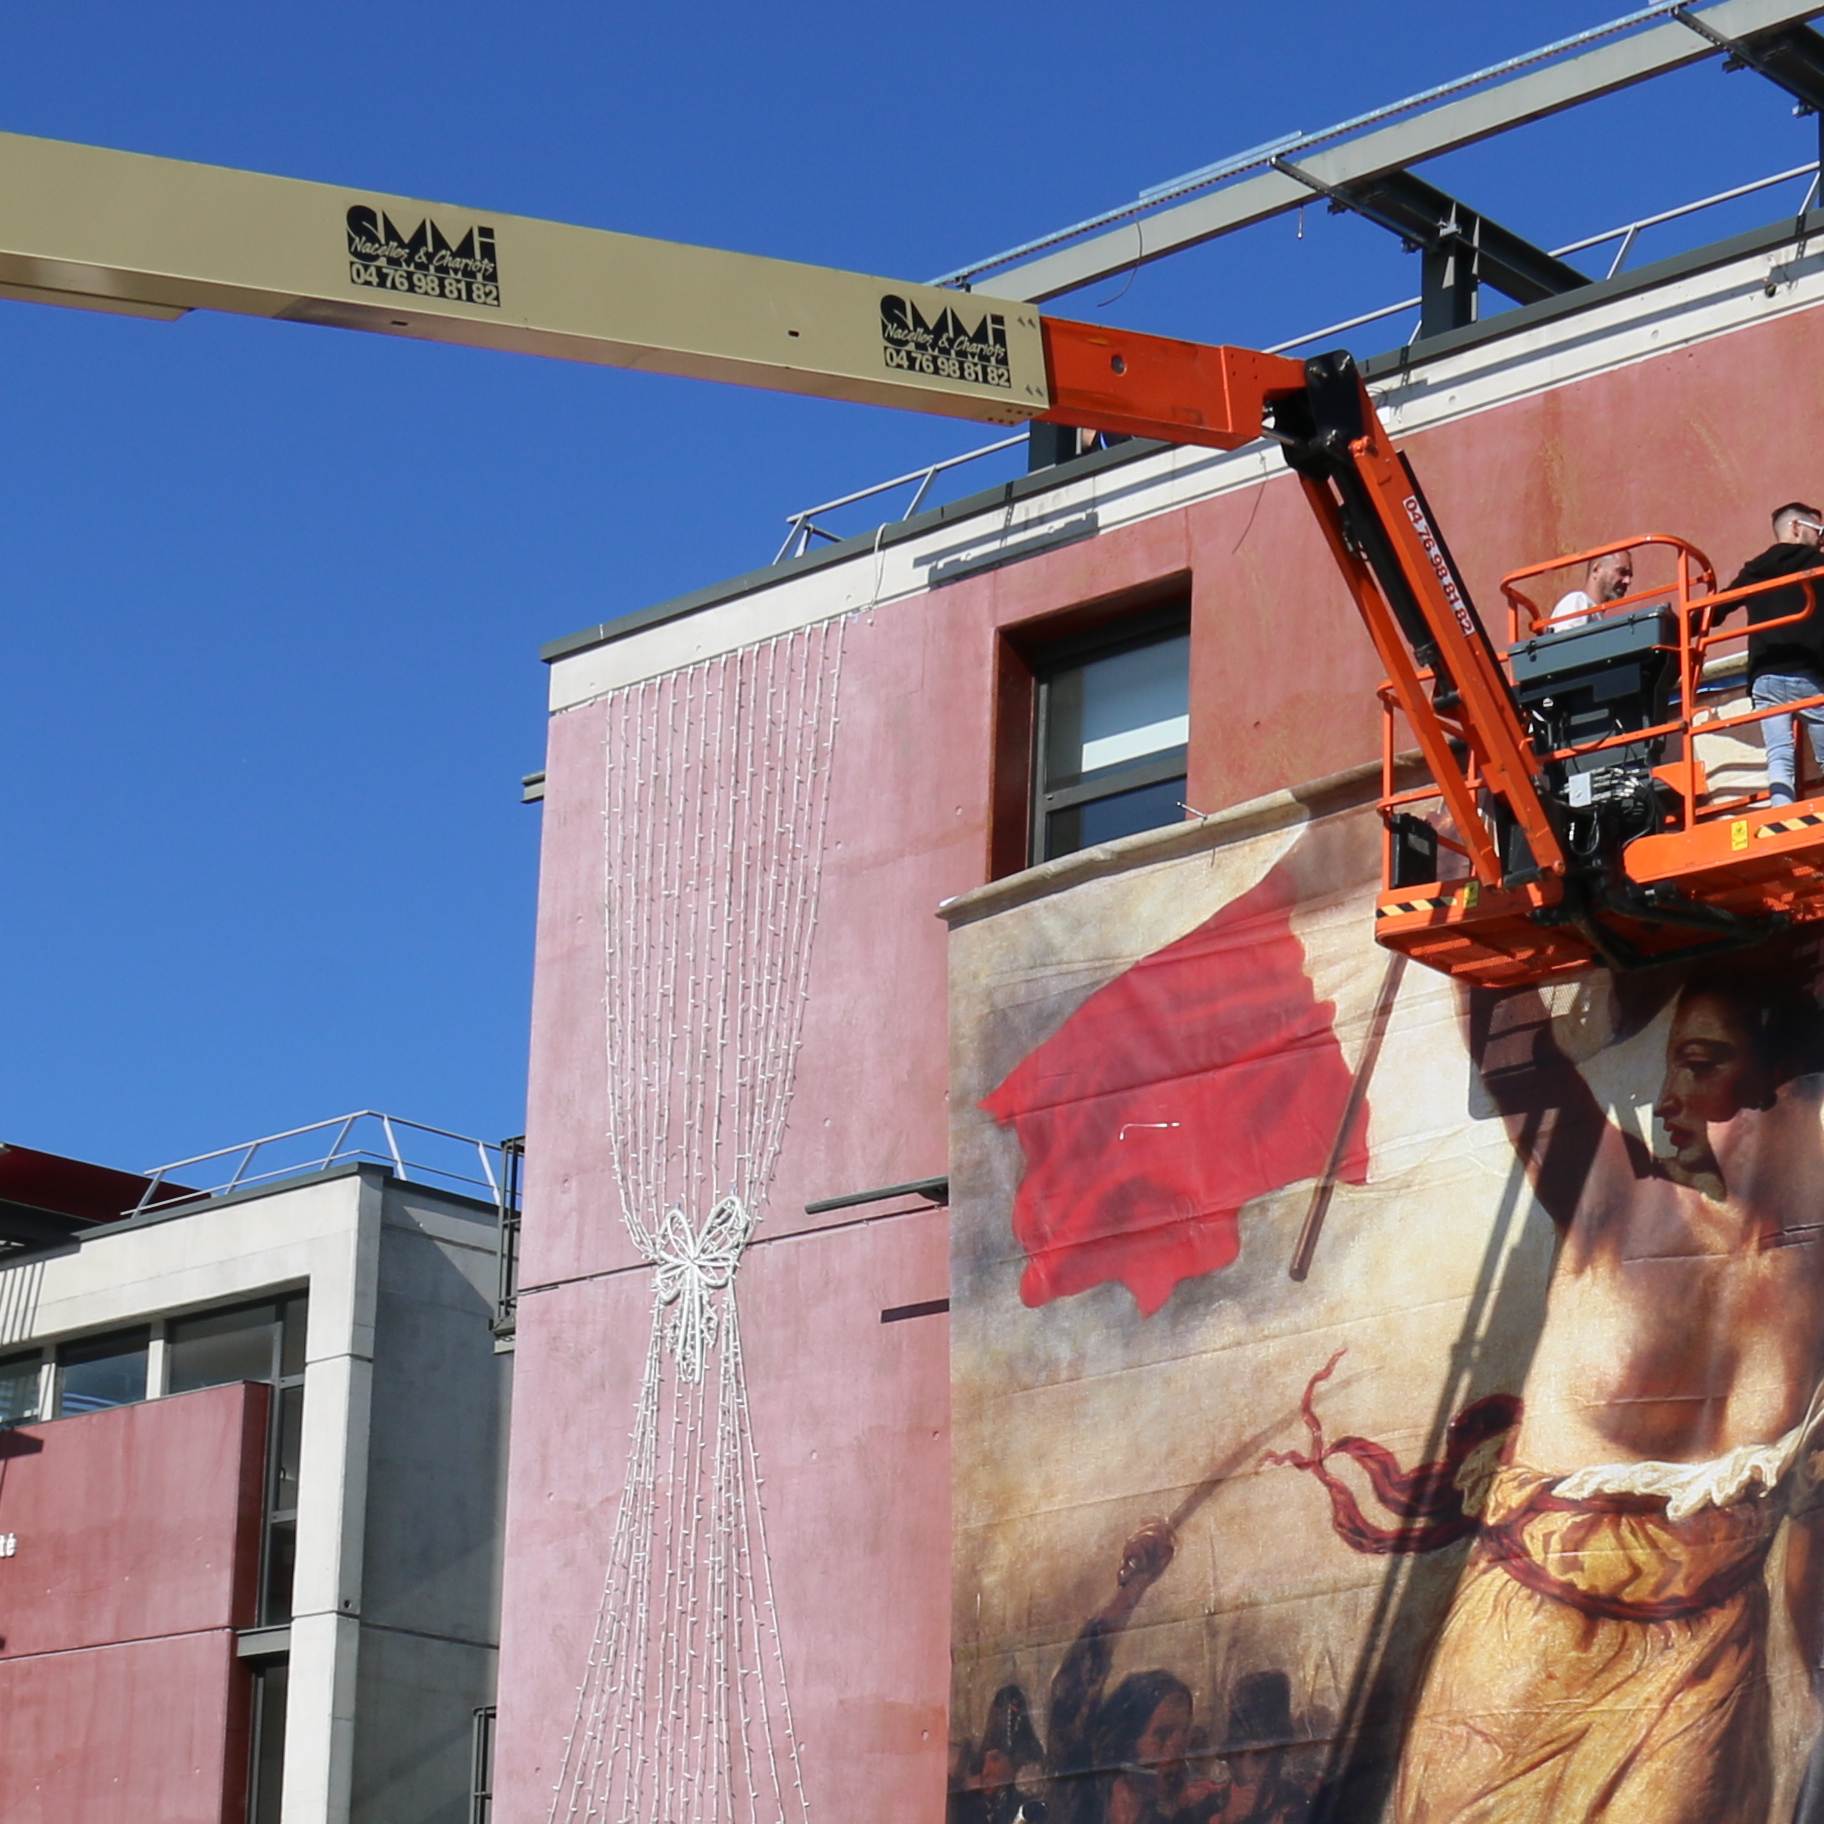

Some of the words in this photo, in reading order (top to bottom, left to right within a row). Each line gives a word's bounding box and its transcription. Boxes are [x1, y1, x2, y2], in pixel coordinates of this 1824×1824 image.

[351, 237, 409, 261] Nacelles
[415, 247, 429, 263] &
[433, 250, 495, 276] Chariots
[351, 263, 379, 286] 04
[382, 268, 409, 291] 76
[413, 273, 440, 296] 98
[444, 278, 468, 301] 81
[472, 283, 498, 306] 82
[938, 332, 950, 349] &
[885, 348, 909, 369] 04
[911, 353, 934, 374] 76
[937, 357, 960, 378] 98
[963, 362, 983, 382] 81
[987, 366, 1010, 387] 82
[1405, 498, 1423, 524] 04
[1418, 525, 1436, 551] 76
[1430, 554, 1448, 580] 98
[1443, 582, 1461, 605] 81
[1455, 607, 1473, 635] 82
